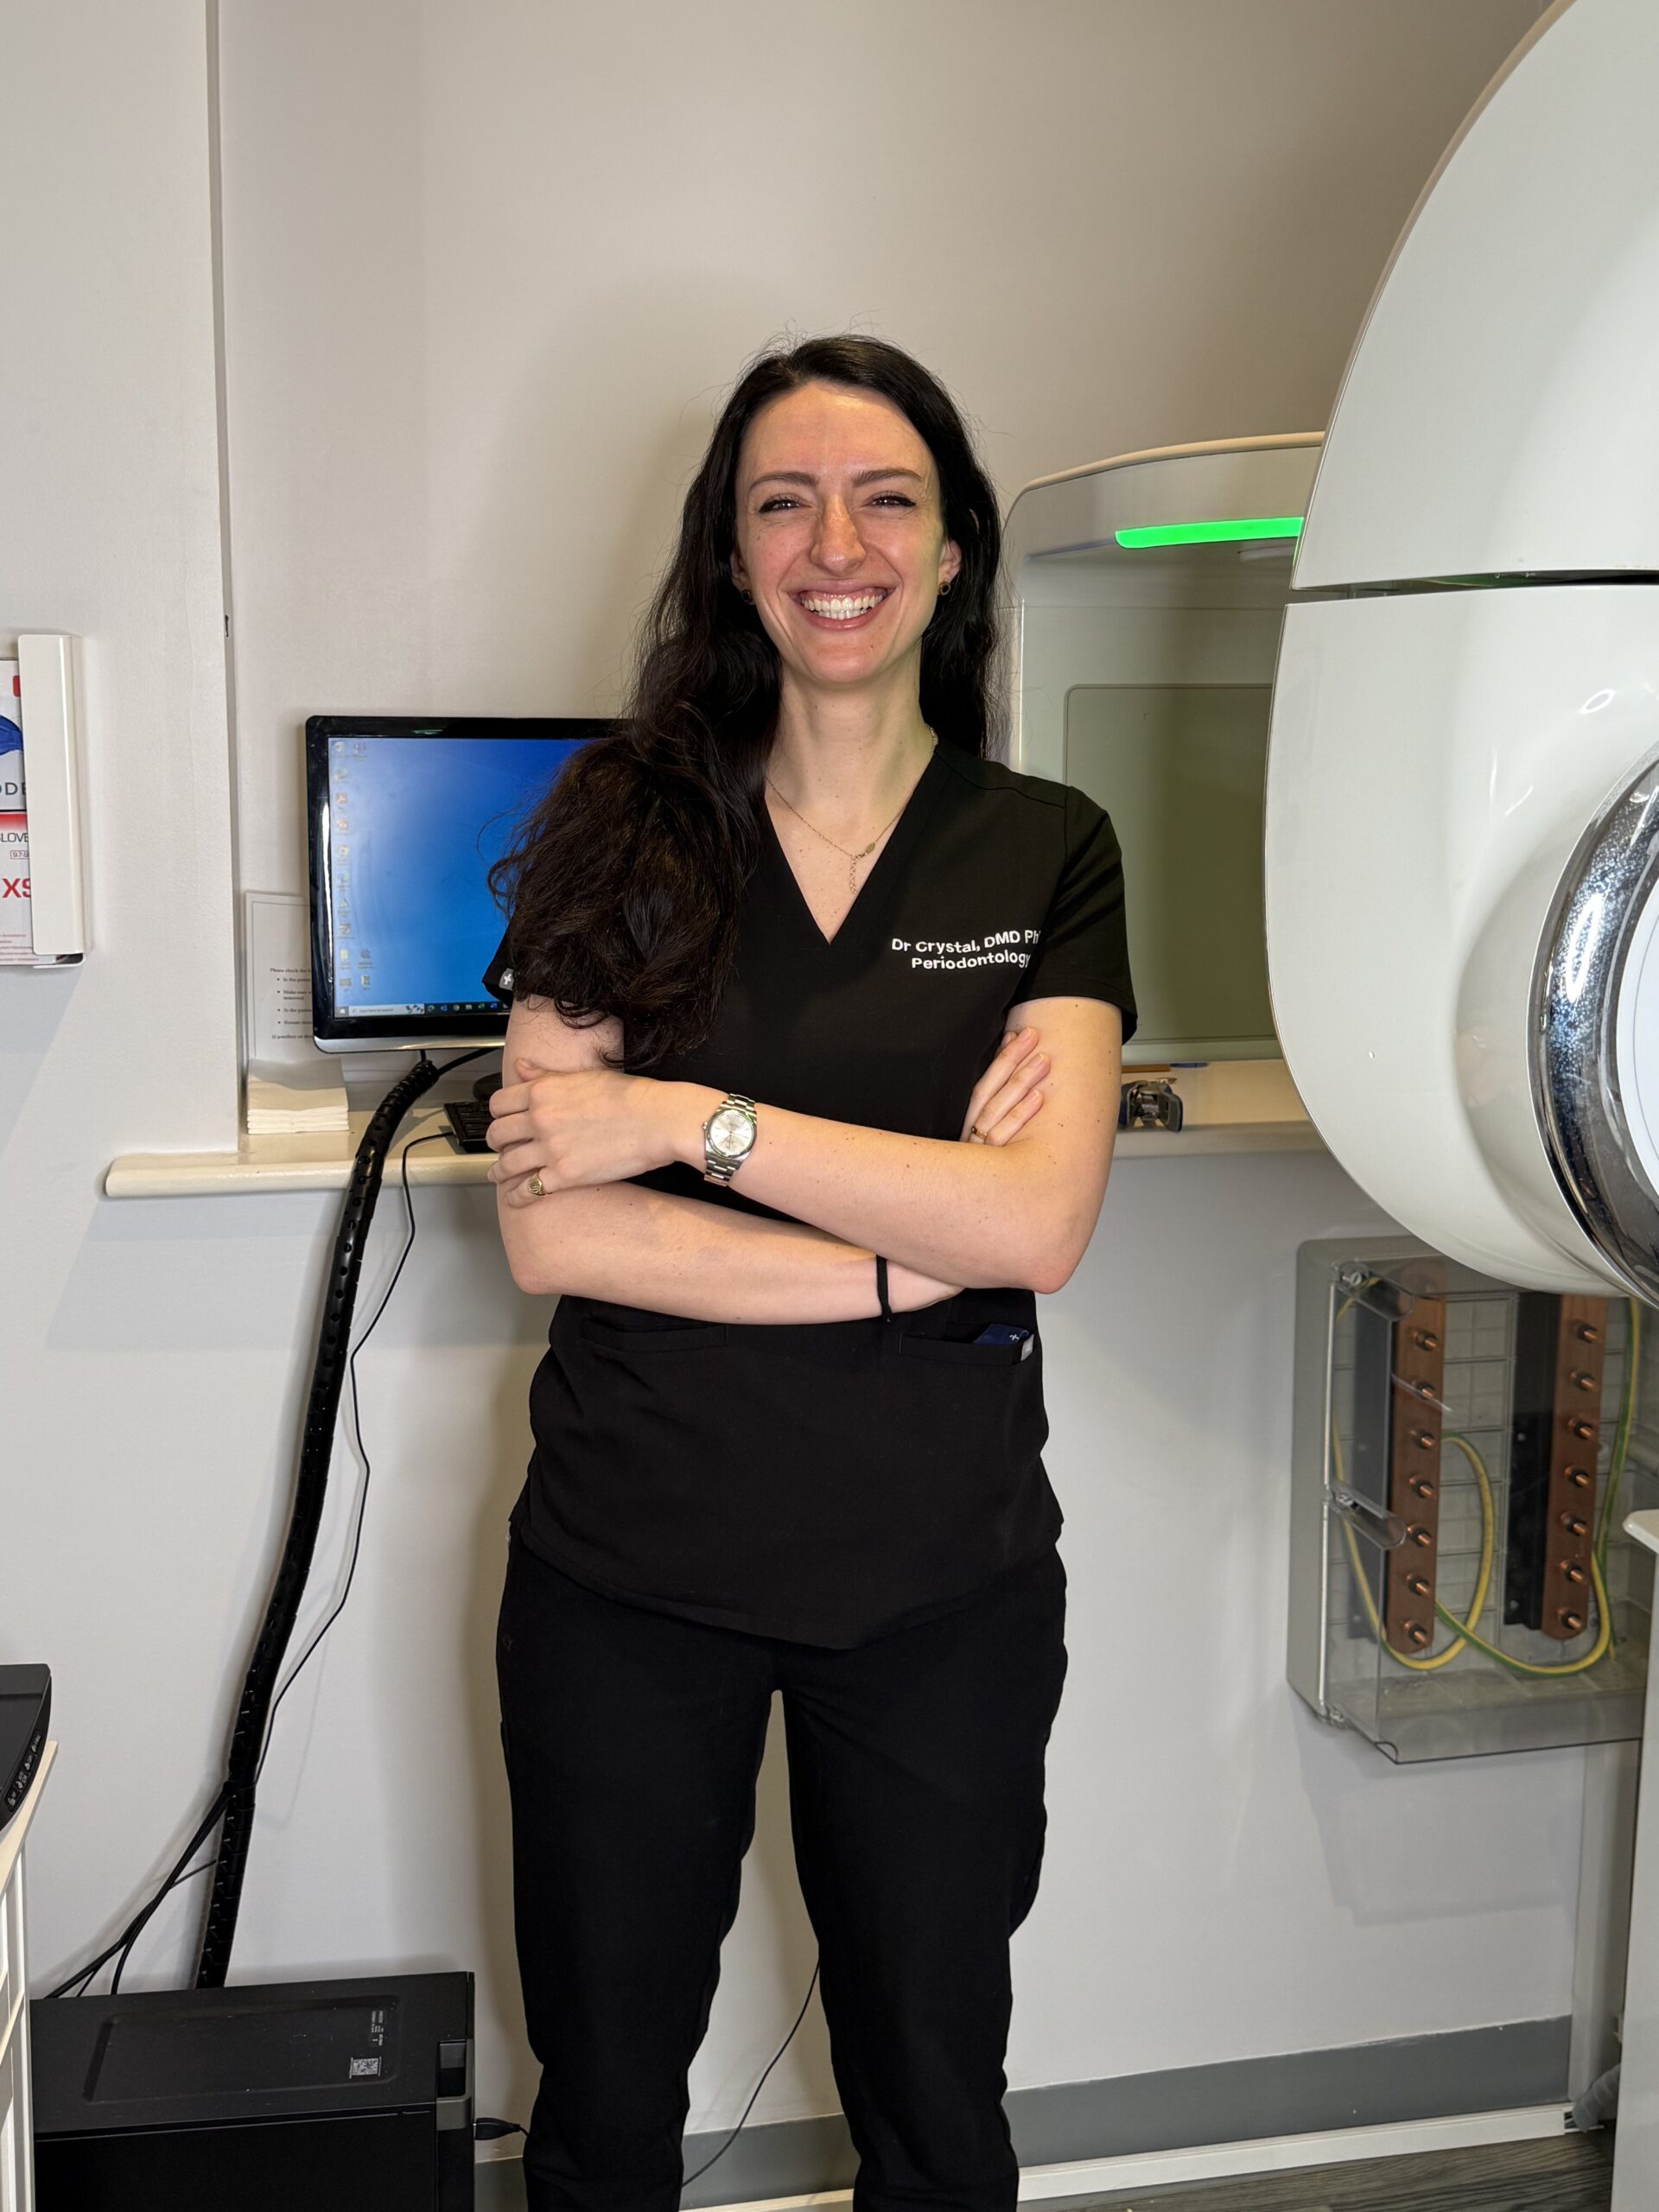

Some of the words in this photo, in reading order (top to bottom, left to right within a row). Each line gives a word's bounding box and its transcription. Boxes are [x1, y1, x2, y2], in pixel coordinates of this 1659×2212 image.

[0, 833, 29, 842] LOVE
[892, 938, 912, 952] Dr
[915, 940, 980, 955] Crystal,
[984, 930, 1020, 949] DMD
[1025, 930, 1041, 944] Ph
[912, 950, 1031, 969] Periodontology
